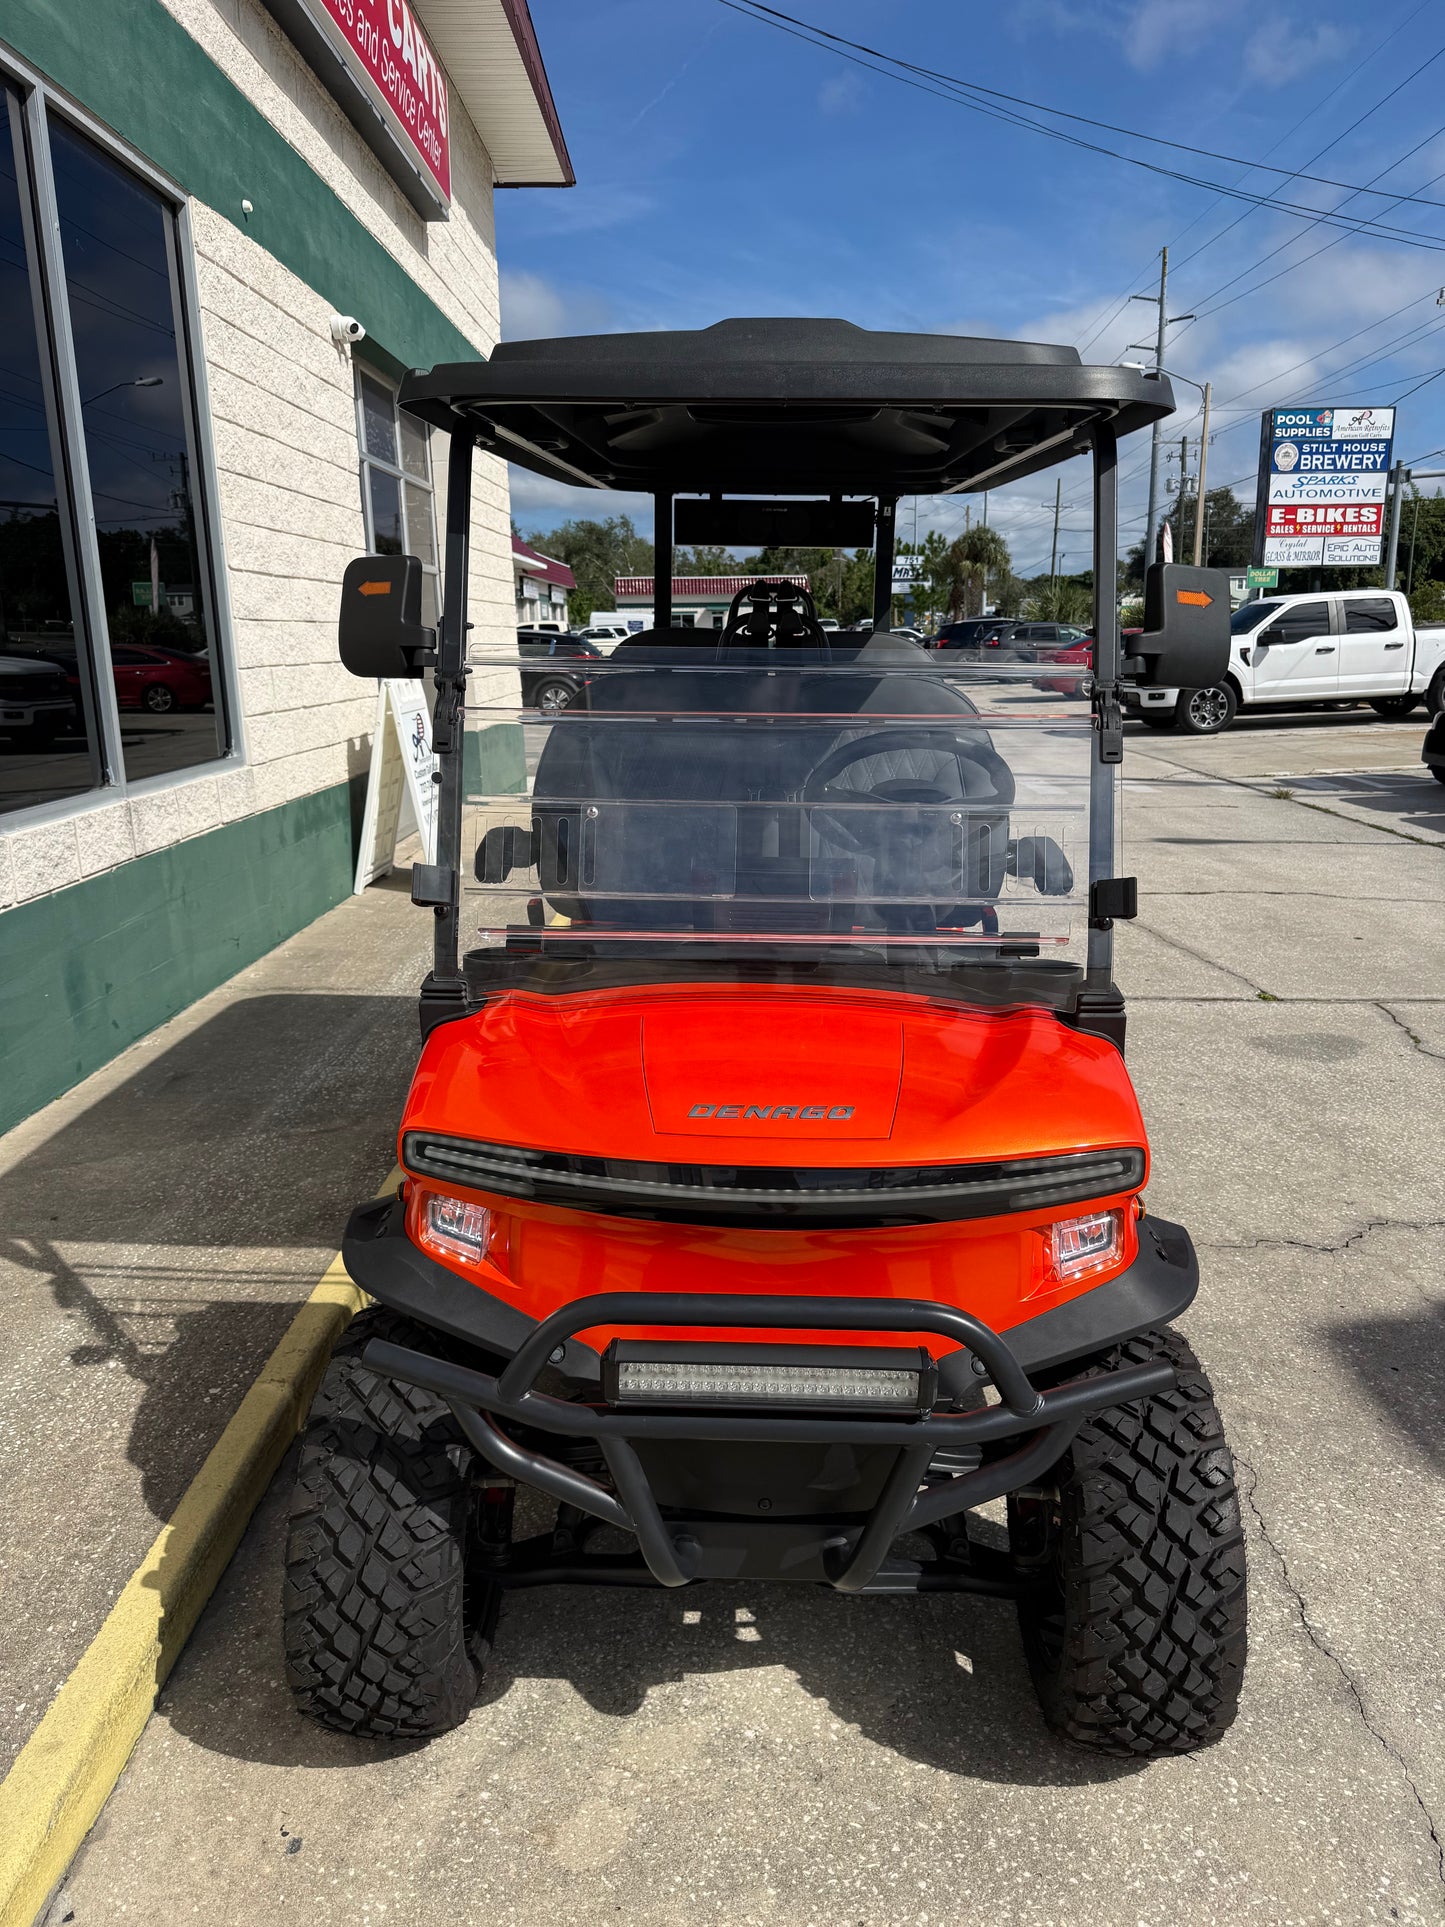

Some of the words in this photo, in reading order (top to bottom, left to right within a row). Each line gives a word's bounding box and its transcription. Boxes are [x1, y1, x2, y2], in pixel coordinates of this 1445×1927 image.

[387, 0, 447, 138] CARTS
[357, 9, 378, 67] and
[380, 38, 416, 126] Service
[417, 101, 442, 171] Center
[1276, 414, 1313, 425] POOL
[1275, 427, 1331, 437] SUPPLIES
[1334, 424, 1363, 433] American
[1302, 443, 1338, 453] STILT
[1342, 442, 1386, 452] HOUSE
[1300, 454, 1385, 470] BREWERY
[1292, 475, 1359, 488] SPARKS
[1273, 488, 1382, 499] AUTOMOTIVE
[1271, 507, 1378, 524] E-BIKES
[1270, 525, 1294, 534] SALES
[1302, 524, 1335, 533] SERVICE
[1342, 524, 1377, 533] RENTALS
[1279, 539, 1308, 551] Crystal
[1265, 551, 1286, 564] GLASS
[1286, 551, 1292, 561] &
[1292, 550, 1321, 562] MIRROR
[687, 1103, 856, 1120] DENAGO
